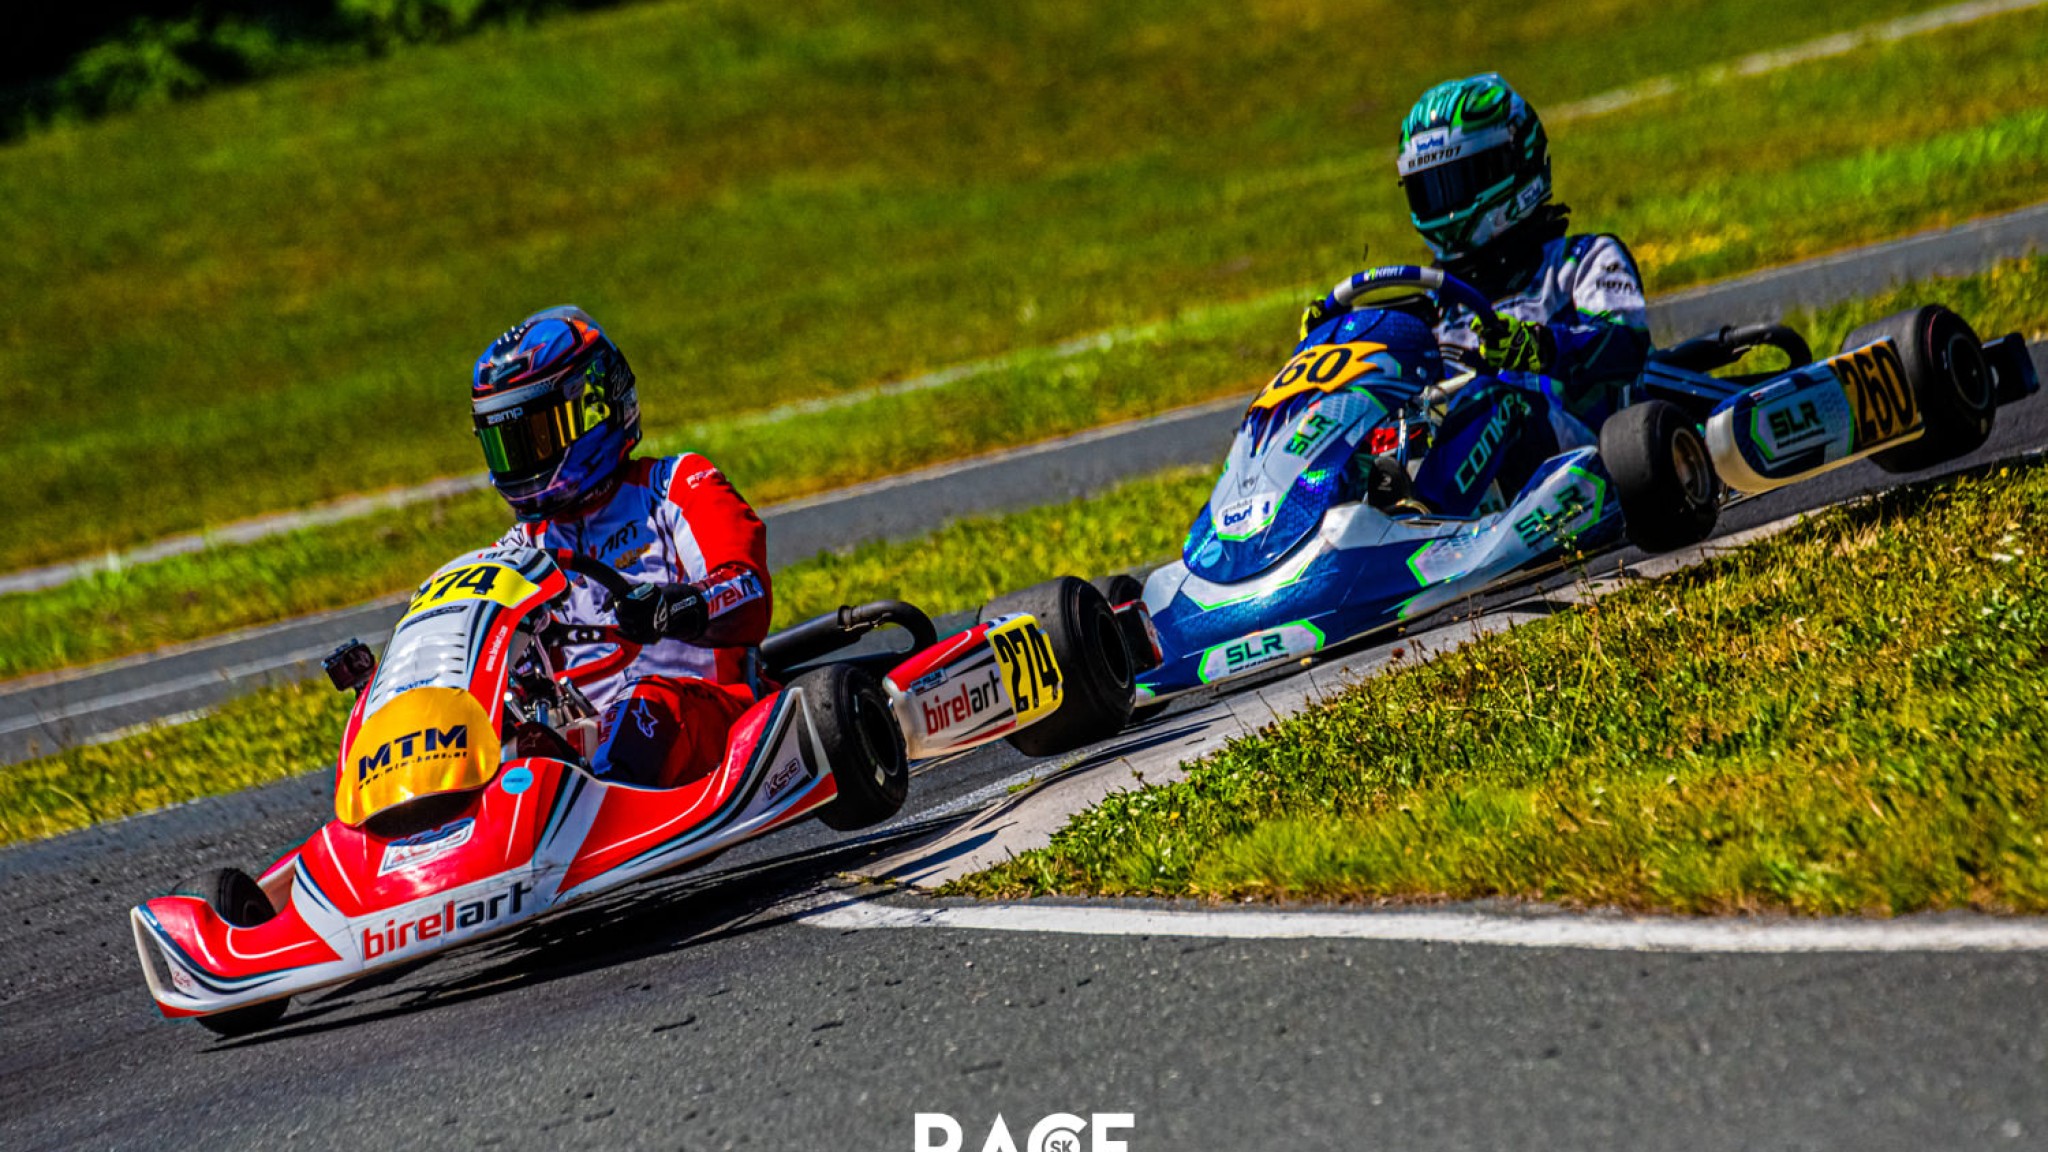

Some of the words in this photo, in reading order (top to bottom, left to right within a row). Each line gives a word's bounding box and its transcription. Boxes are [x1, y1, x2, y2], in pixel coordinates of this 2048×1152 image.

[1262, 348, 1353, 396] 60
[1835, 346, 1914, 443] 260
[1285, 413, 1334, 456] SLR
[1768, 400, 1821, 439] SLR
[1516, 485, 1590, 541] SLR
[993, 623, 1060, 714] 274
[1226, 634, 1285, 666] SLR
[923, 669, 1001, 736] birelart
[359, 725, 468, 782] MTM
[362, 881, 532, 961] birelart
